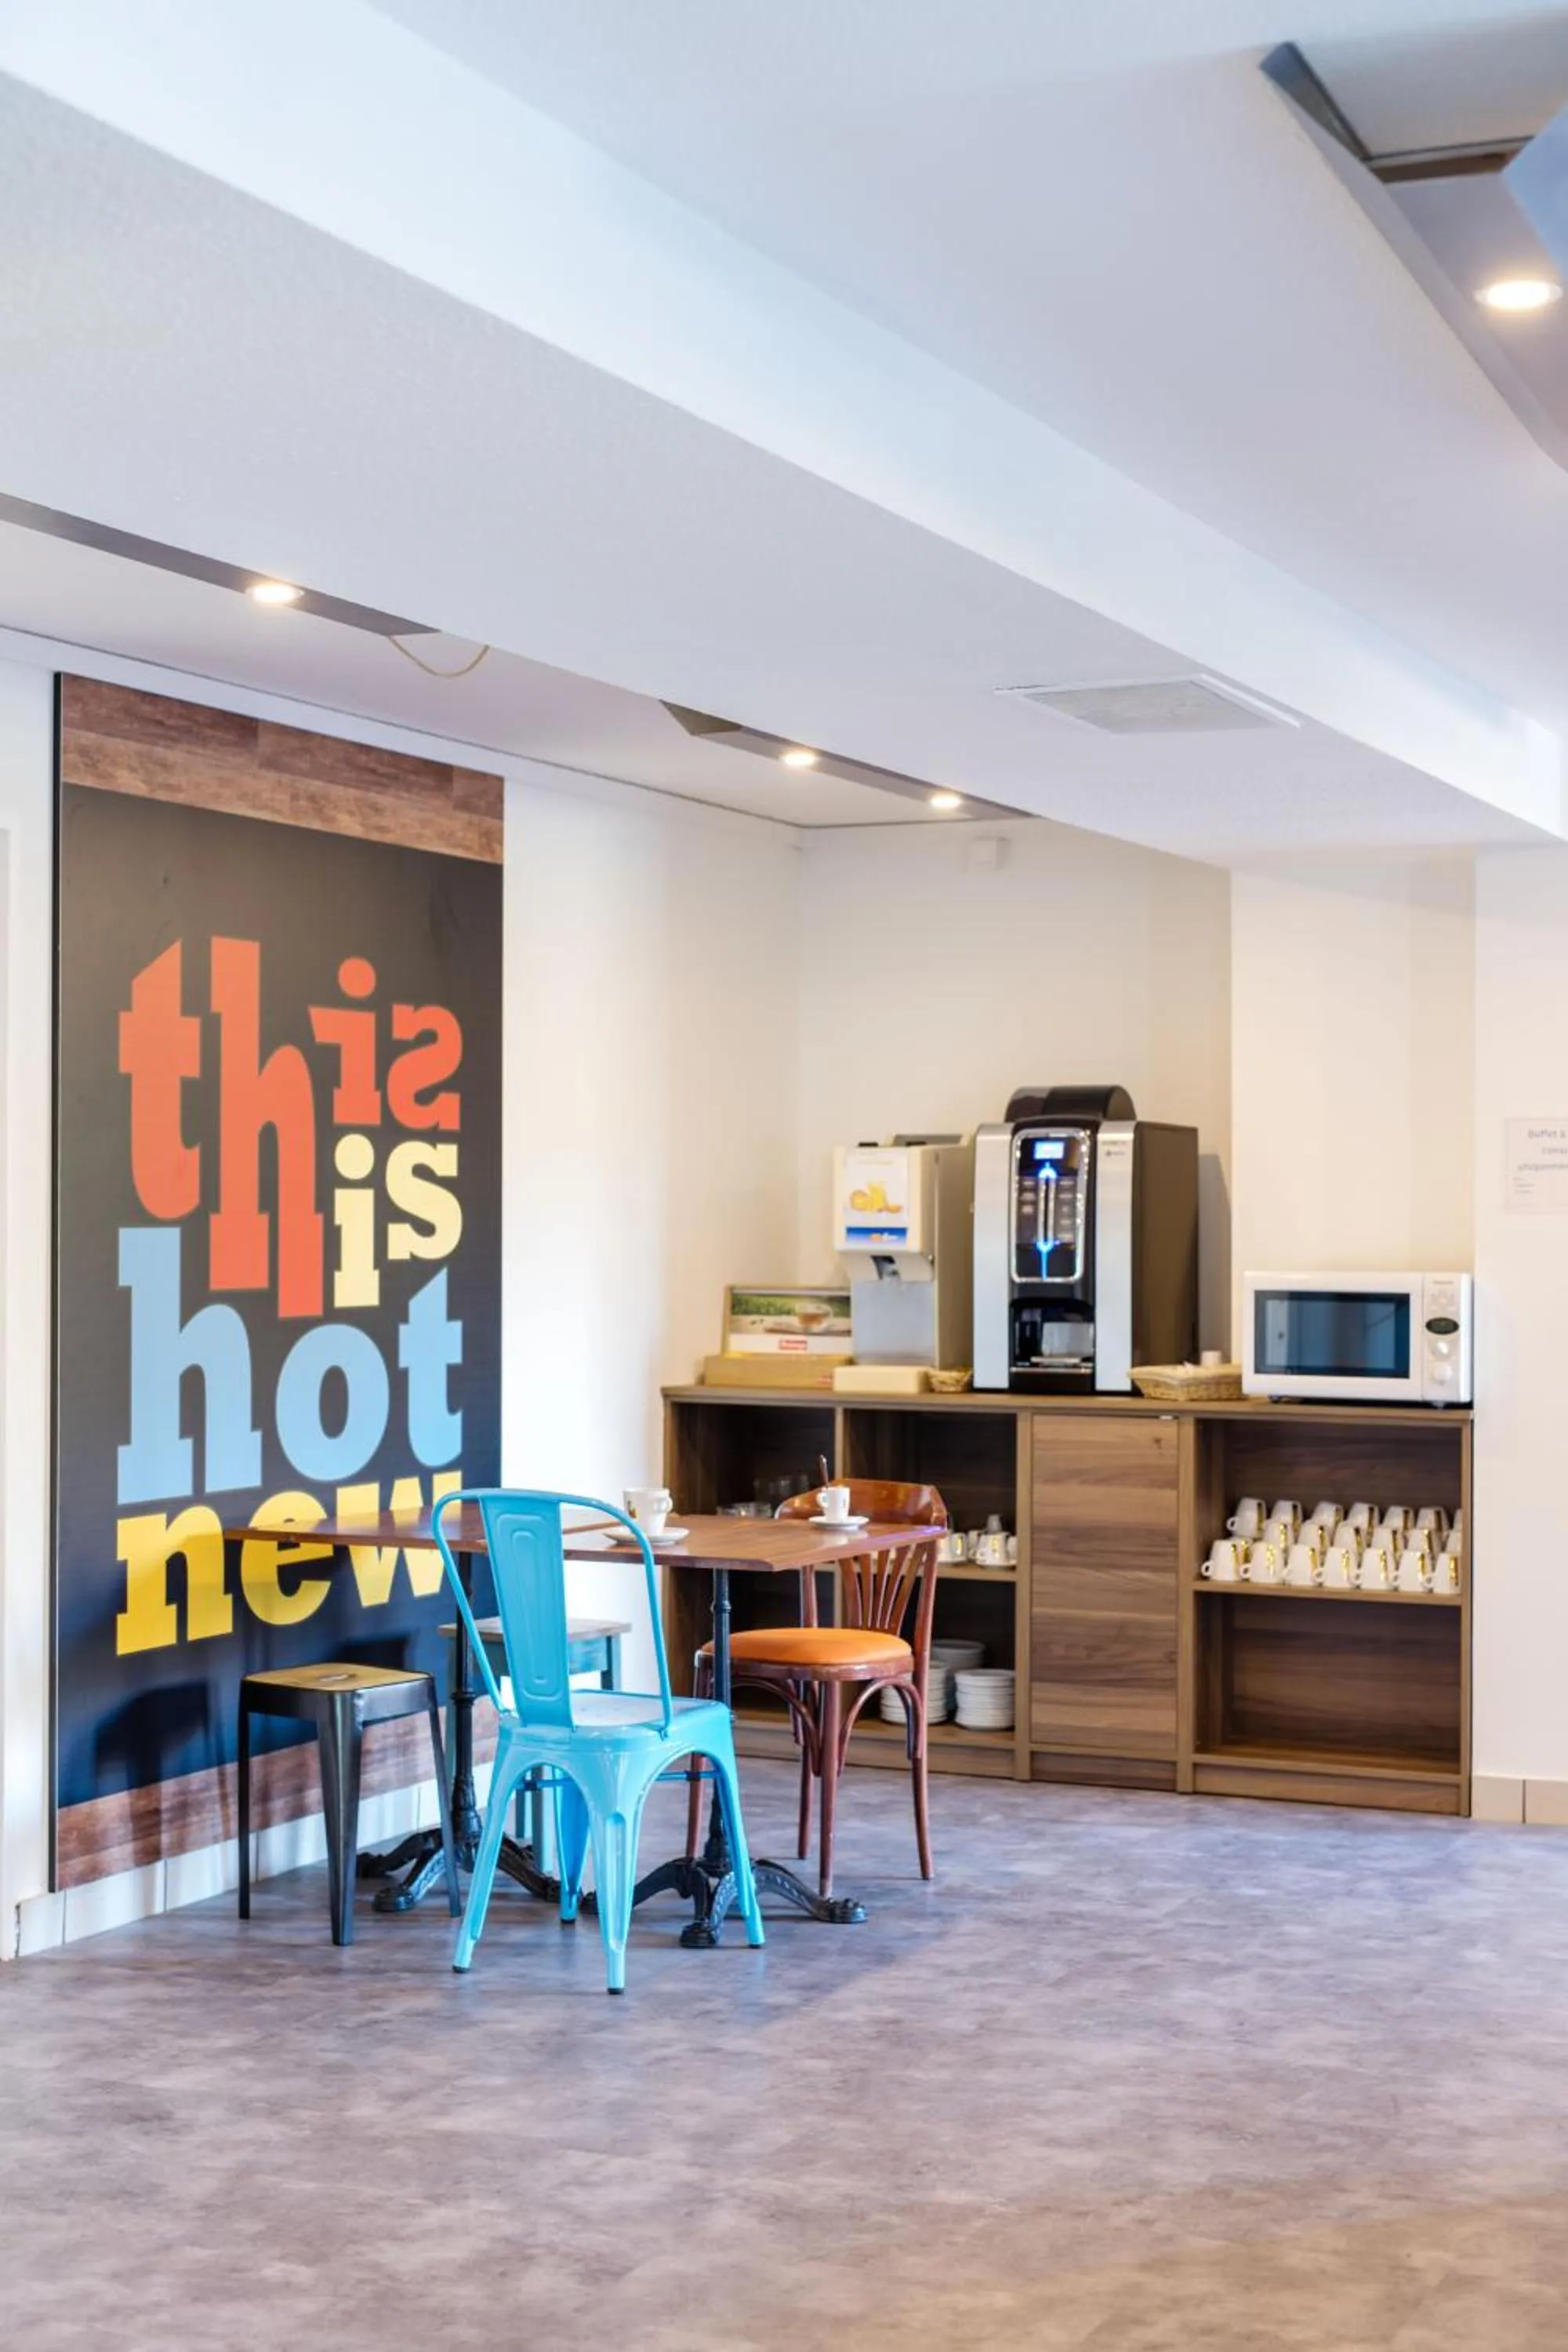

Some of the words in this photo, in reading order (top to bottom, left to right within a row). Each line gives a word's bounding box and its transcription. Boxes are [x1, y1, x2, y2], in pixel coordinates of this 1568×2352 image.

[118, 936, 463, 1318] this
[333, 1134, 463, 1308] is
[117, 1226, 463, 1505] hot
[115, 1471, 463, 1656] new
